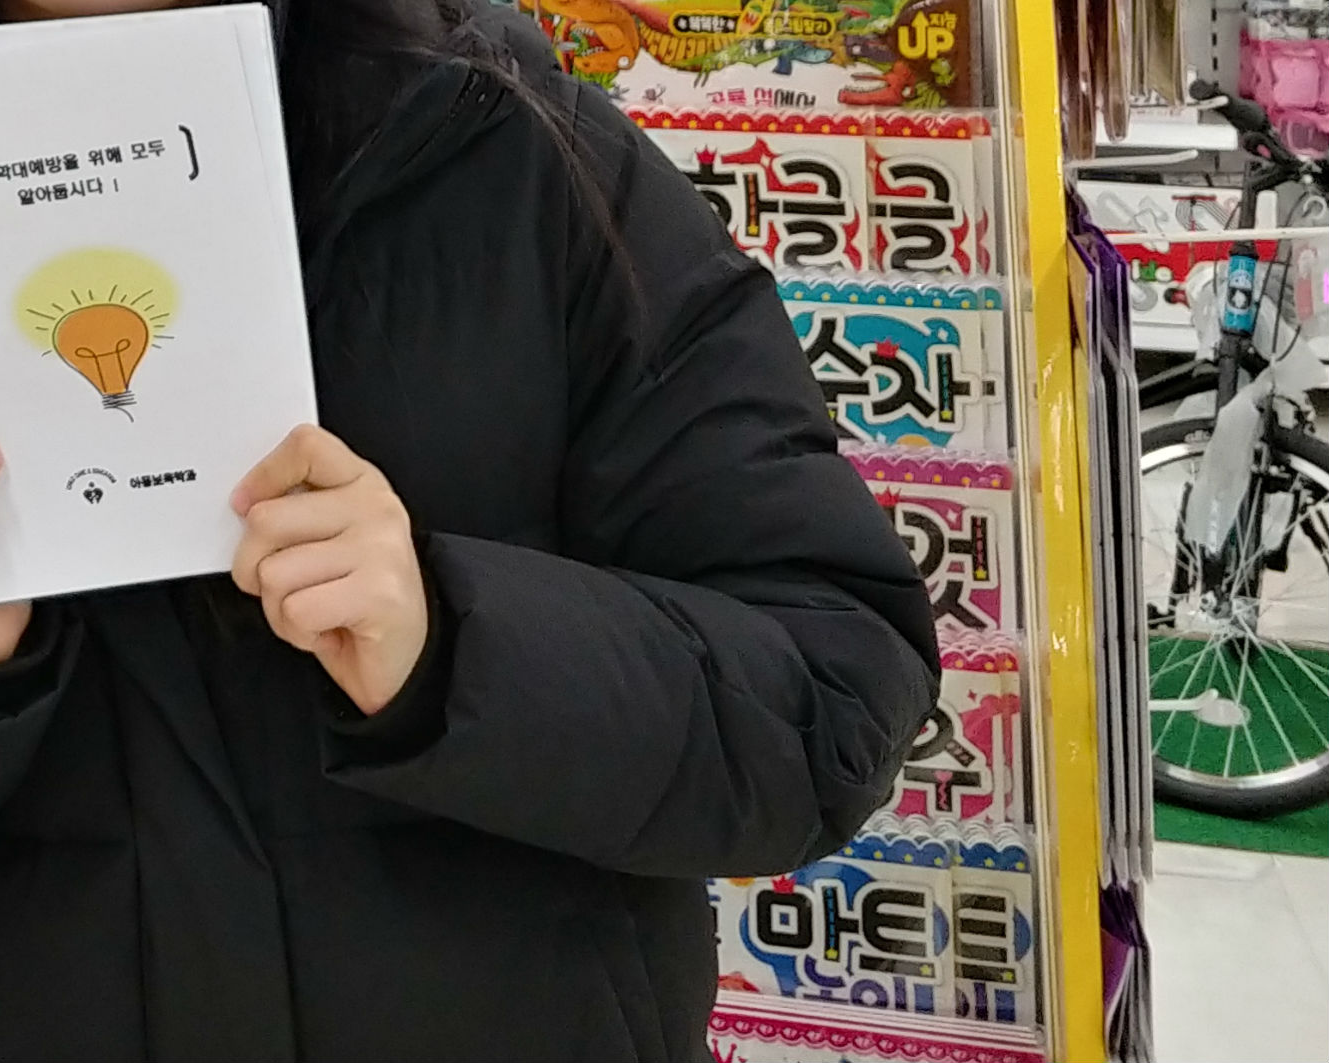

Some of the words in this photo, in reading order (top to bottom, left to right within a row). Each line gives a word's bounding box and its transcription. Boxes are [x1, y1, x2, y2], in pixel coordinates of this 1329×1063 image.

[898, 10, 955, 59] UP
[88, 145, 124, 167] 위해
[130, 139, 166, 161] 모두
[17, 176, 104, 206] 알아둡시다
[755, 881, 936, 982] 마트
